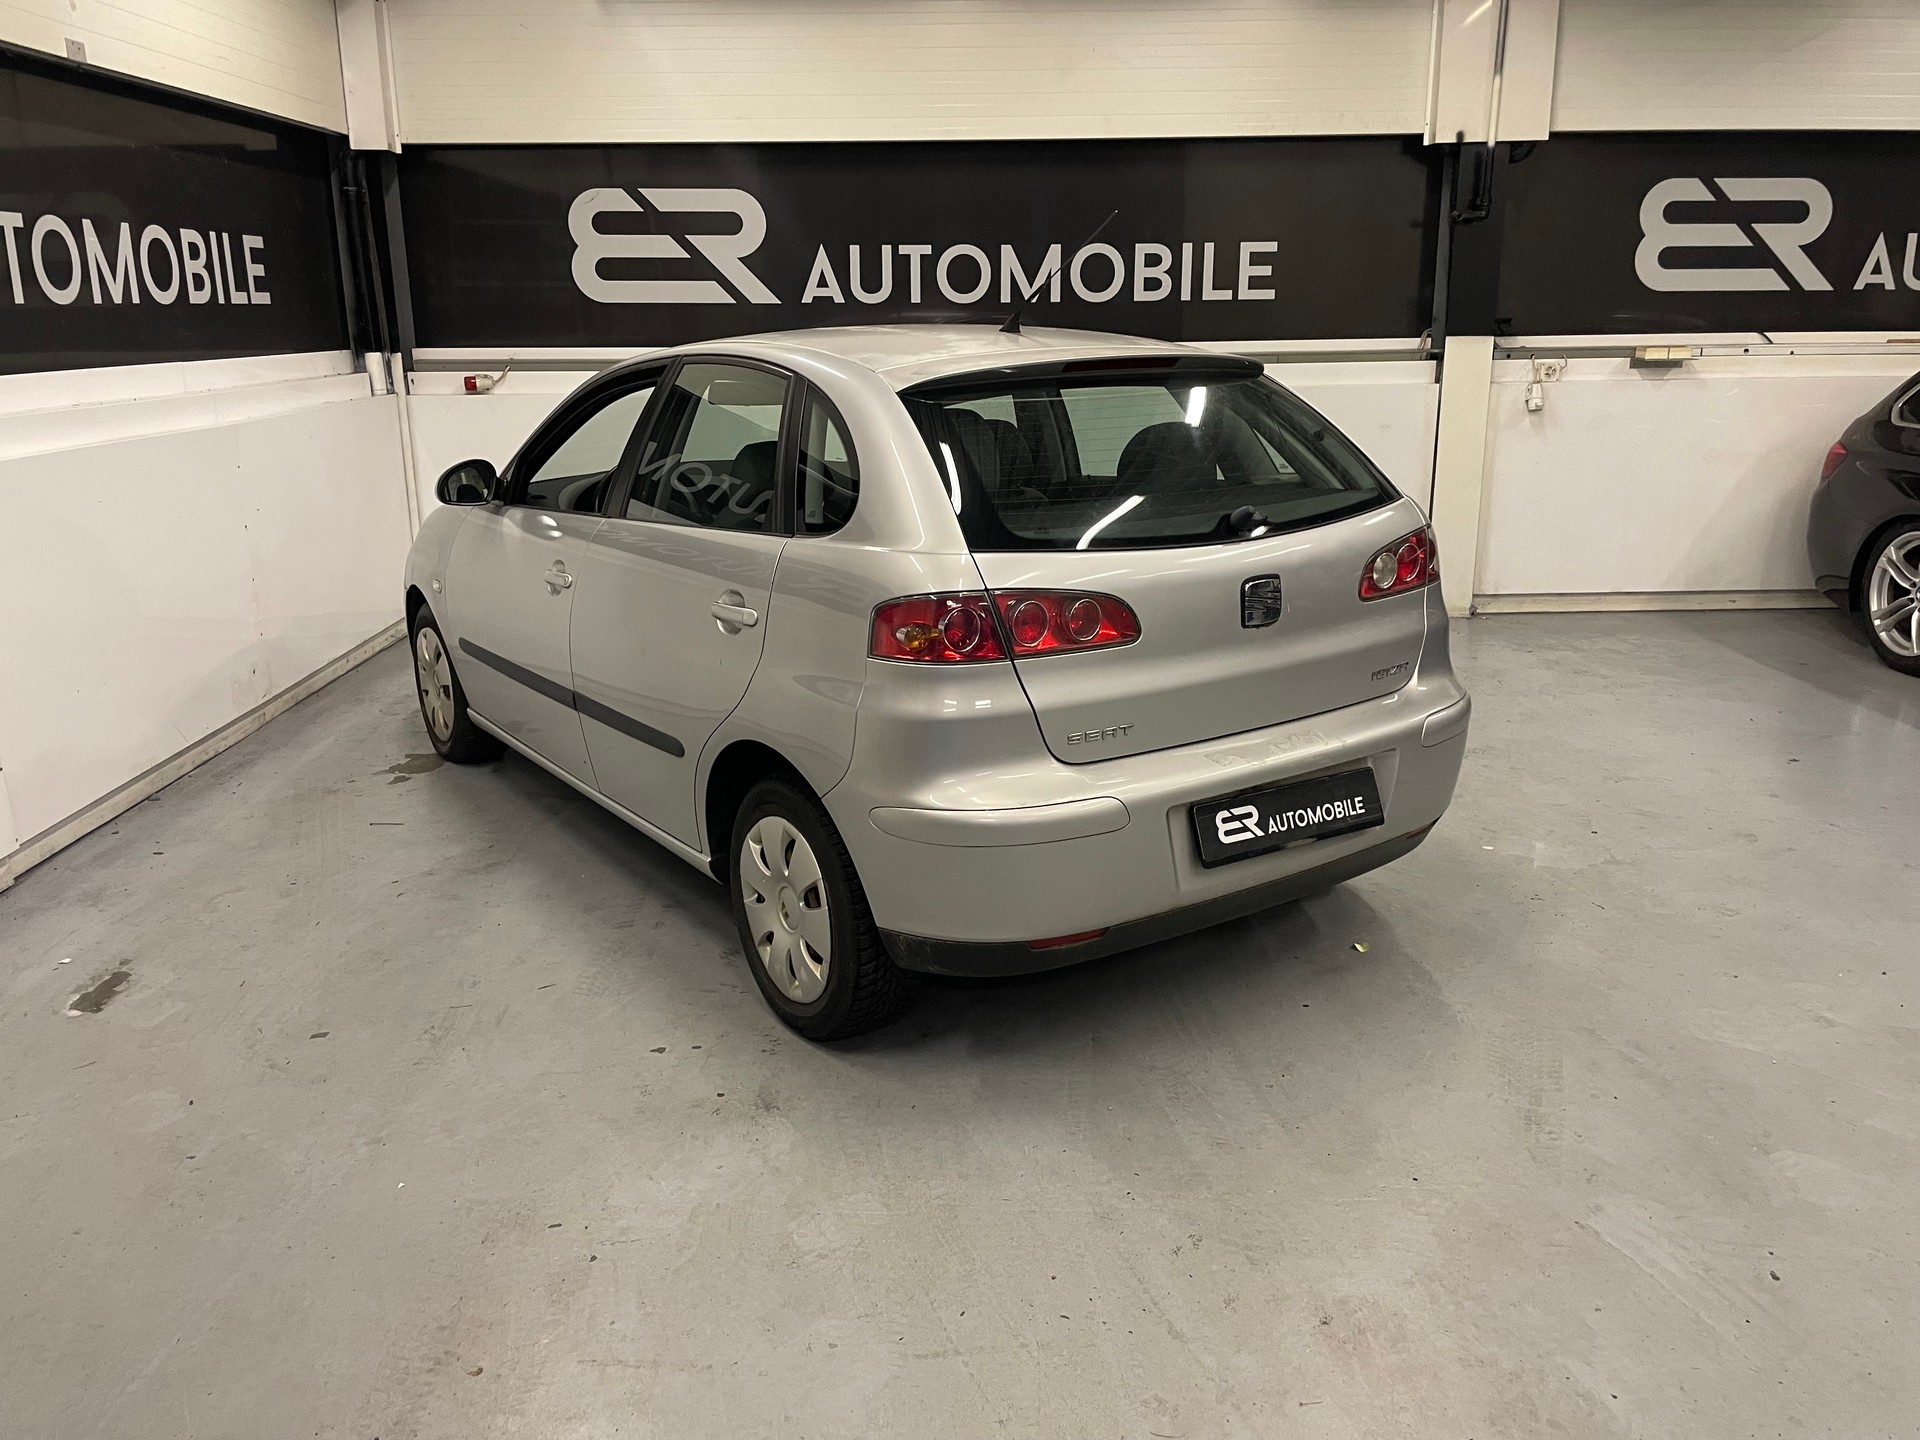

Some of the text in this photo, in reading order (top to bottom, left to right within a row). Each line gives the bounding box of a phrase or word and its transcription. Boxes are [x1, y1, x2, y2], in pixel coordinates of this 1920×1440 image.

[0, 211, 272, 305] TOMOBILE
[803, 241, 1279, 305] AUTOMOBILE
[1067, 723, 1134, 745] SEAT
[1268, 796, 1366, 835] AUTOMOBILE
